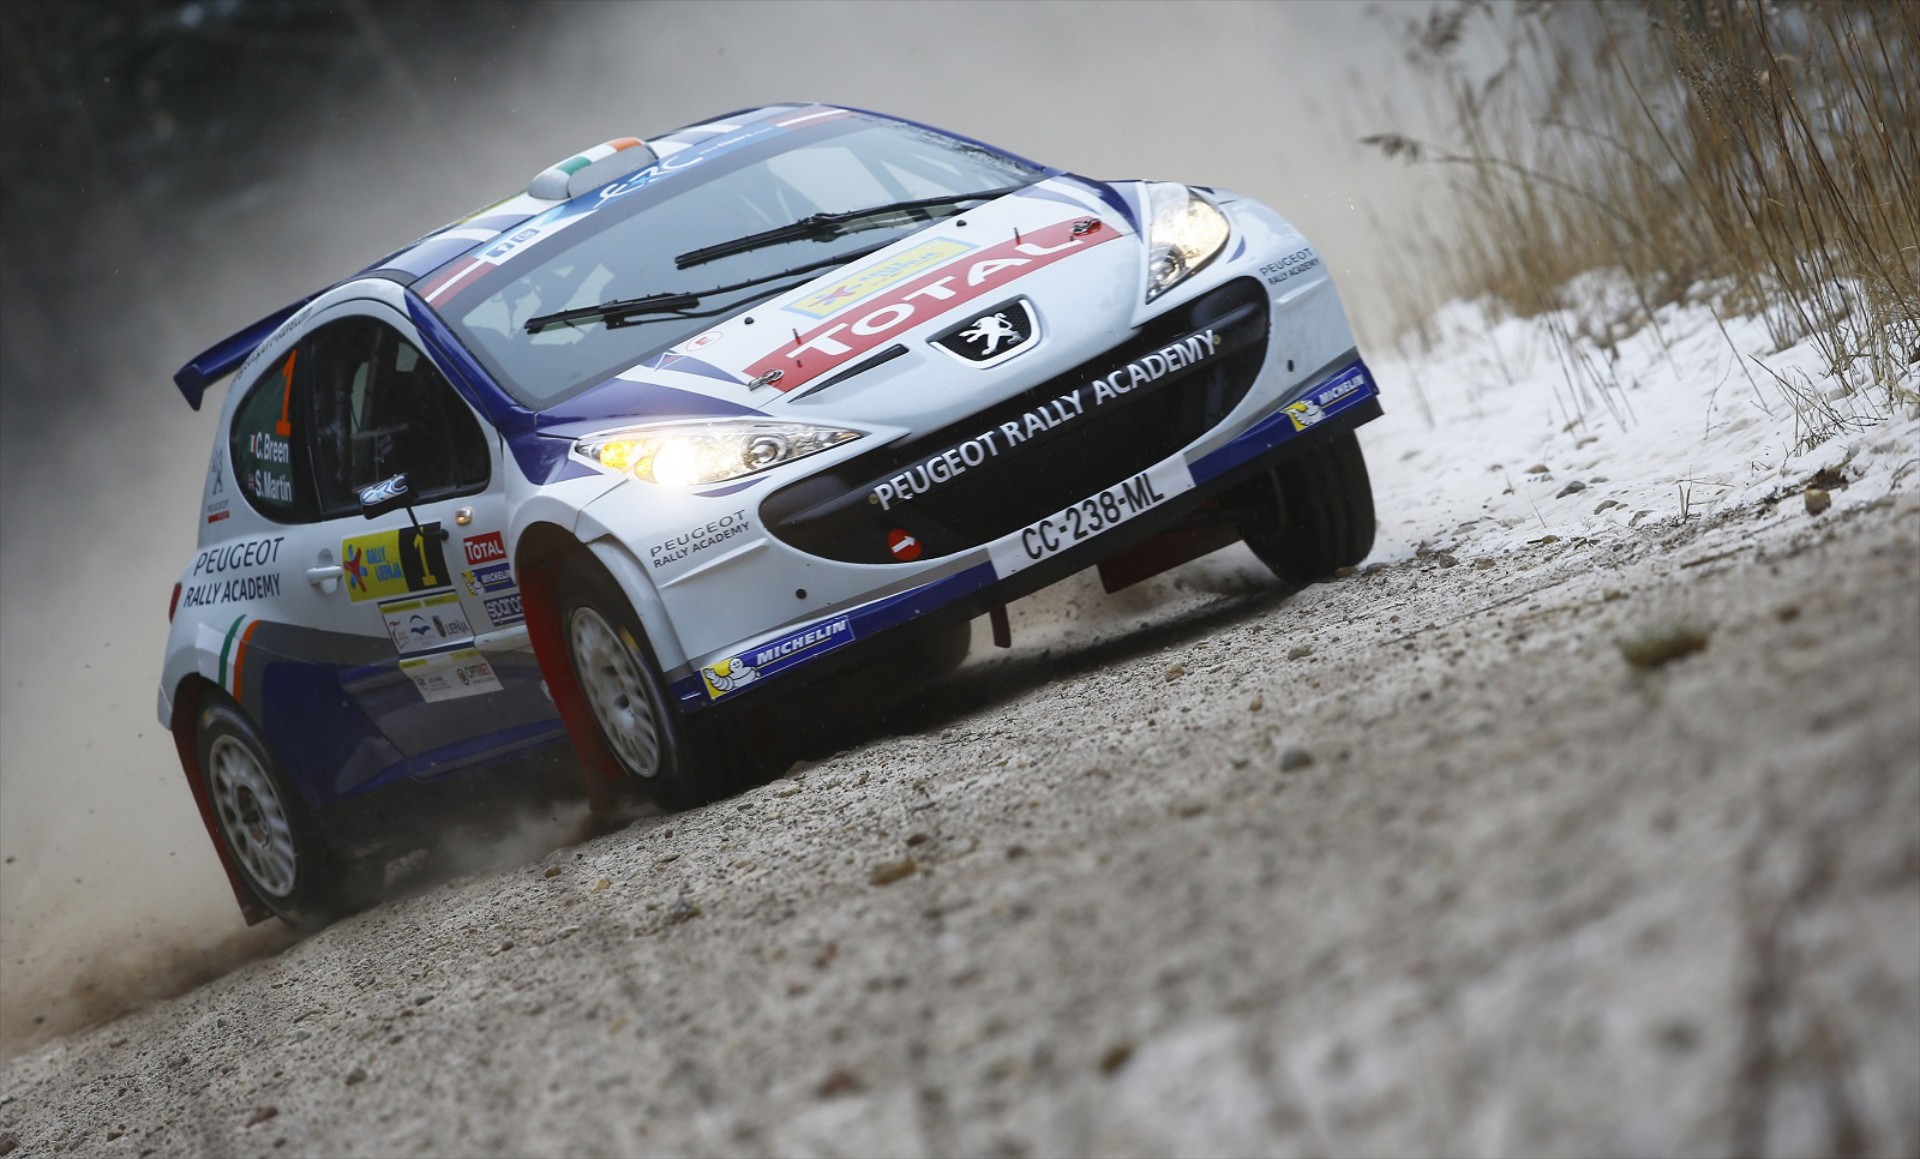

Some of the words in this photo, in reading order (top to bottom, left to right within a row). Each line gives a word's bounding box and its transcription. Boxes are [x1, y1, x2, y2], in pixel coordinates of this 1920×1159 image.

[1259, 248, 1313, 276] PEUGEOT
[1268, 272, 1290, 286] RALLY
[1289, 258, 1320, 278] ACADEMY
[786, 239, 1083, 357] TOTAL
[276, 349, 297, 437] 1
[1319, 375, 1364, 404] MICHELIN
[874, 430, 1000, 511] PEUGEOT
[1000, 390, 1084, 448] RALLY
[1092, 329, 1215, 405] ACADEMY
[651, 509, 746, 557] PEUGEOT
[1022, 472, 1165, 560] CC-238-ML
[193, 537, 284, 576] PEUGEOT
[414, 527, 438, 586] 1
[465, 541, 504, 560] TOTAL
[654, 547, 689, 569] RALLY
[692, 521, 750, 553] ACADEMY
[183, 583, 222, 608] RALLY
[221, 573, 281, 604] ACADEMY
[757, 620, 847, 666] MICHELIN
